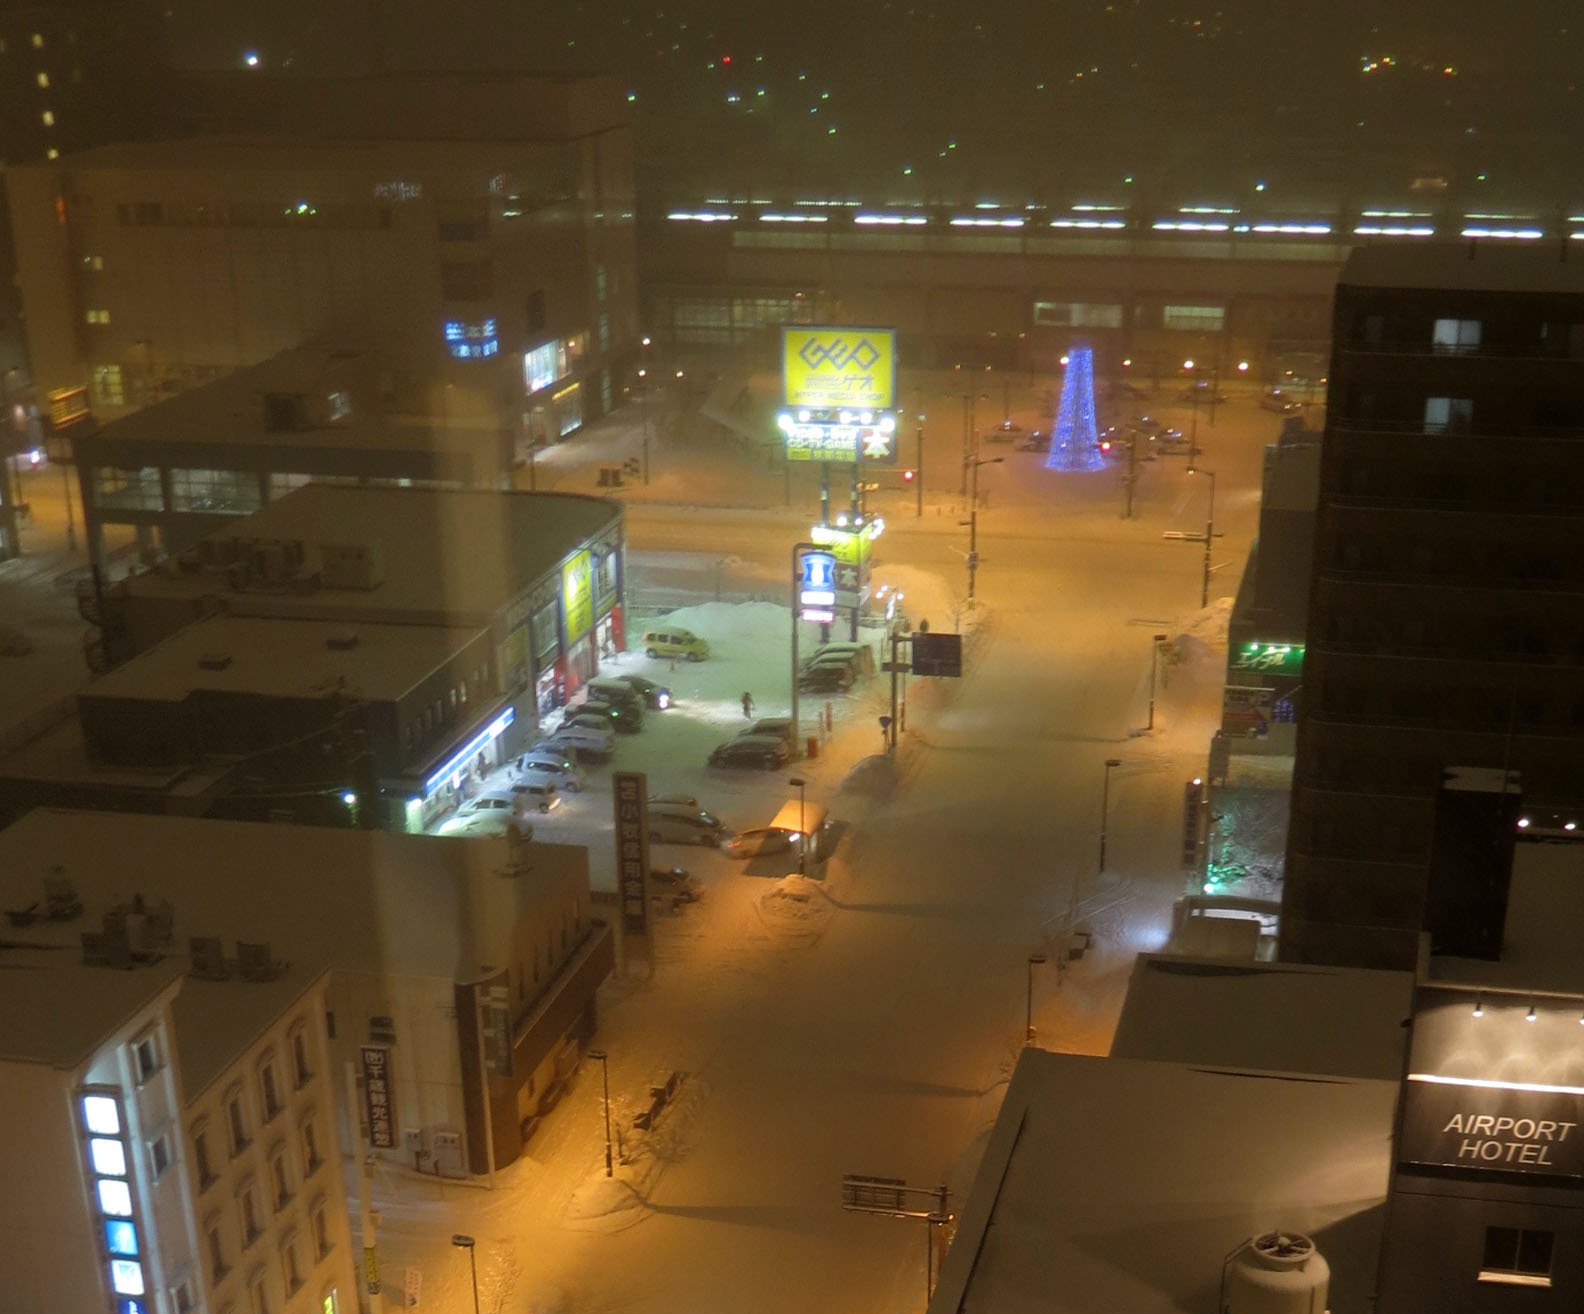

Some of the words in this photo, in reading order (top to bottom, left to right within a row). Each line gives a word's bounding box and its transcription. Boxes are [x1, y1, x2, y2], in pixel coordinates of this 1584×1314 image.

[800, 336, 881, 370] GEO
[1443, 1114, 1577, 1142] AIRPORT
[1458, 1139, 1552, 1165] HOTEL
